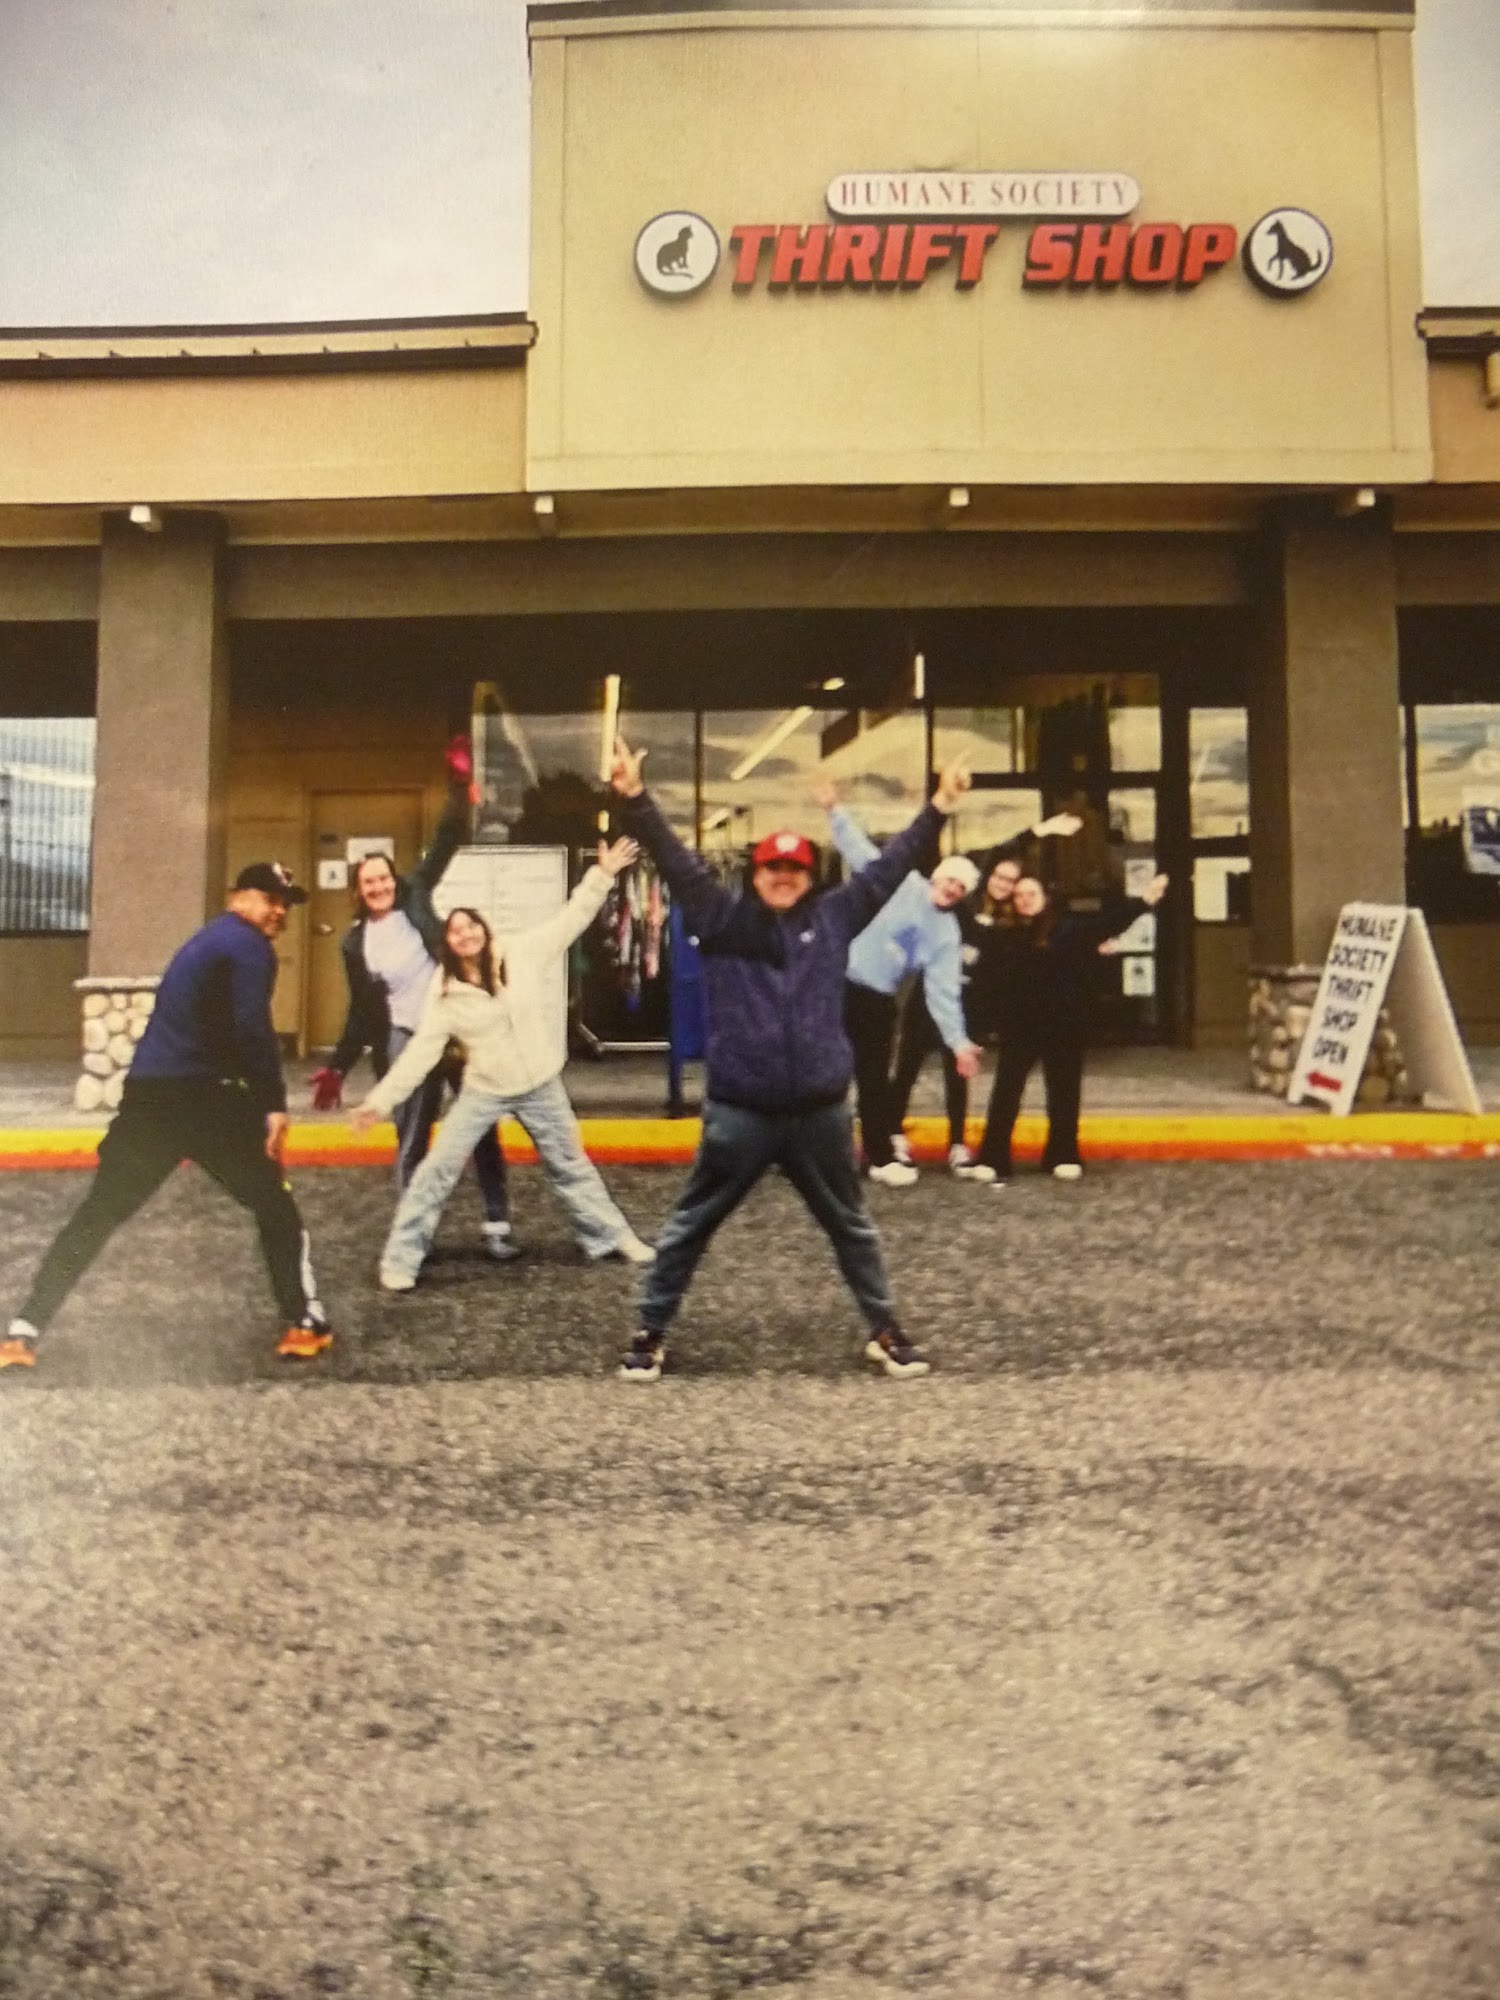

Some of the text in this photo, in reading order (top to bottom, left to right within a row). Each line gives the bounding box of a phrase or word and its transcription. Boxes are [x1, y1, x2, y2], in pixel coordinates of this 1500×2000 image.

[840, 180, 1128, 206] HUMANE SOCIETY
[729, 222, 1238, 286] THRIFT SHOP
[1329, 944, 1388, 973] SOCIETY
[1326, 974, 1374, 1003] THRIFT
[1322, 1006, 1358, 1032] SHOP
[1313, 1036, 1348, 1064] OPEN
